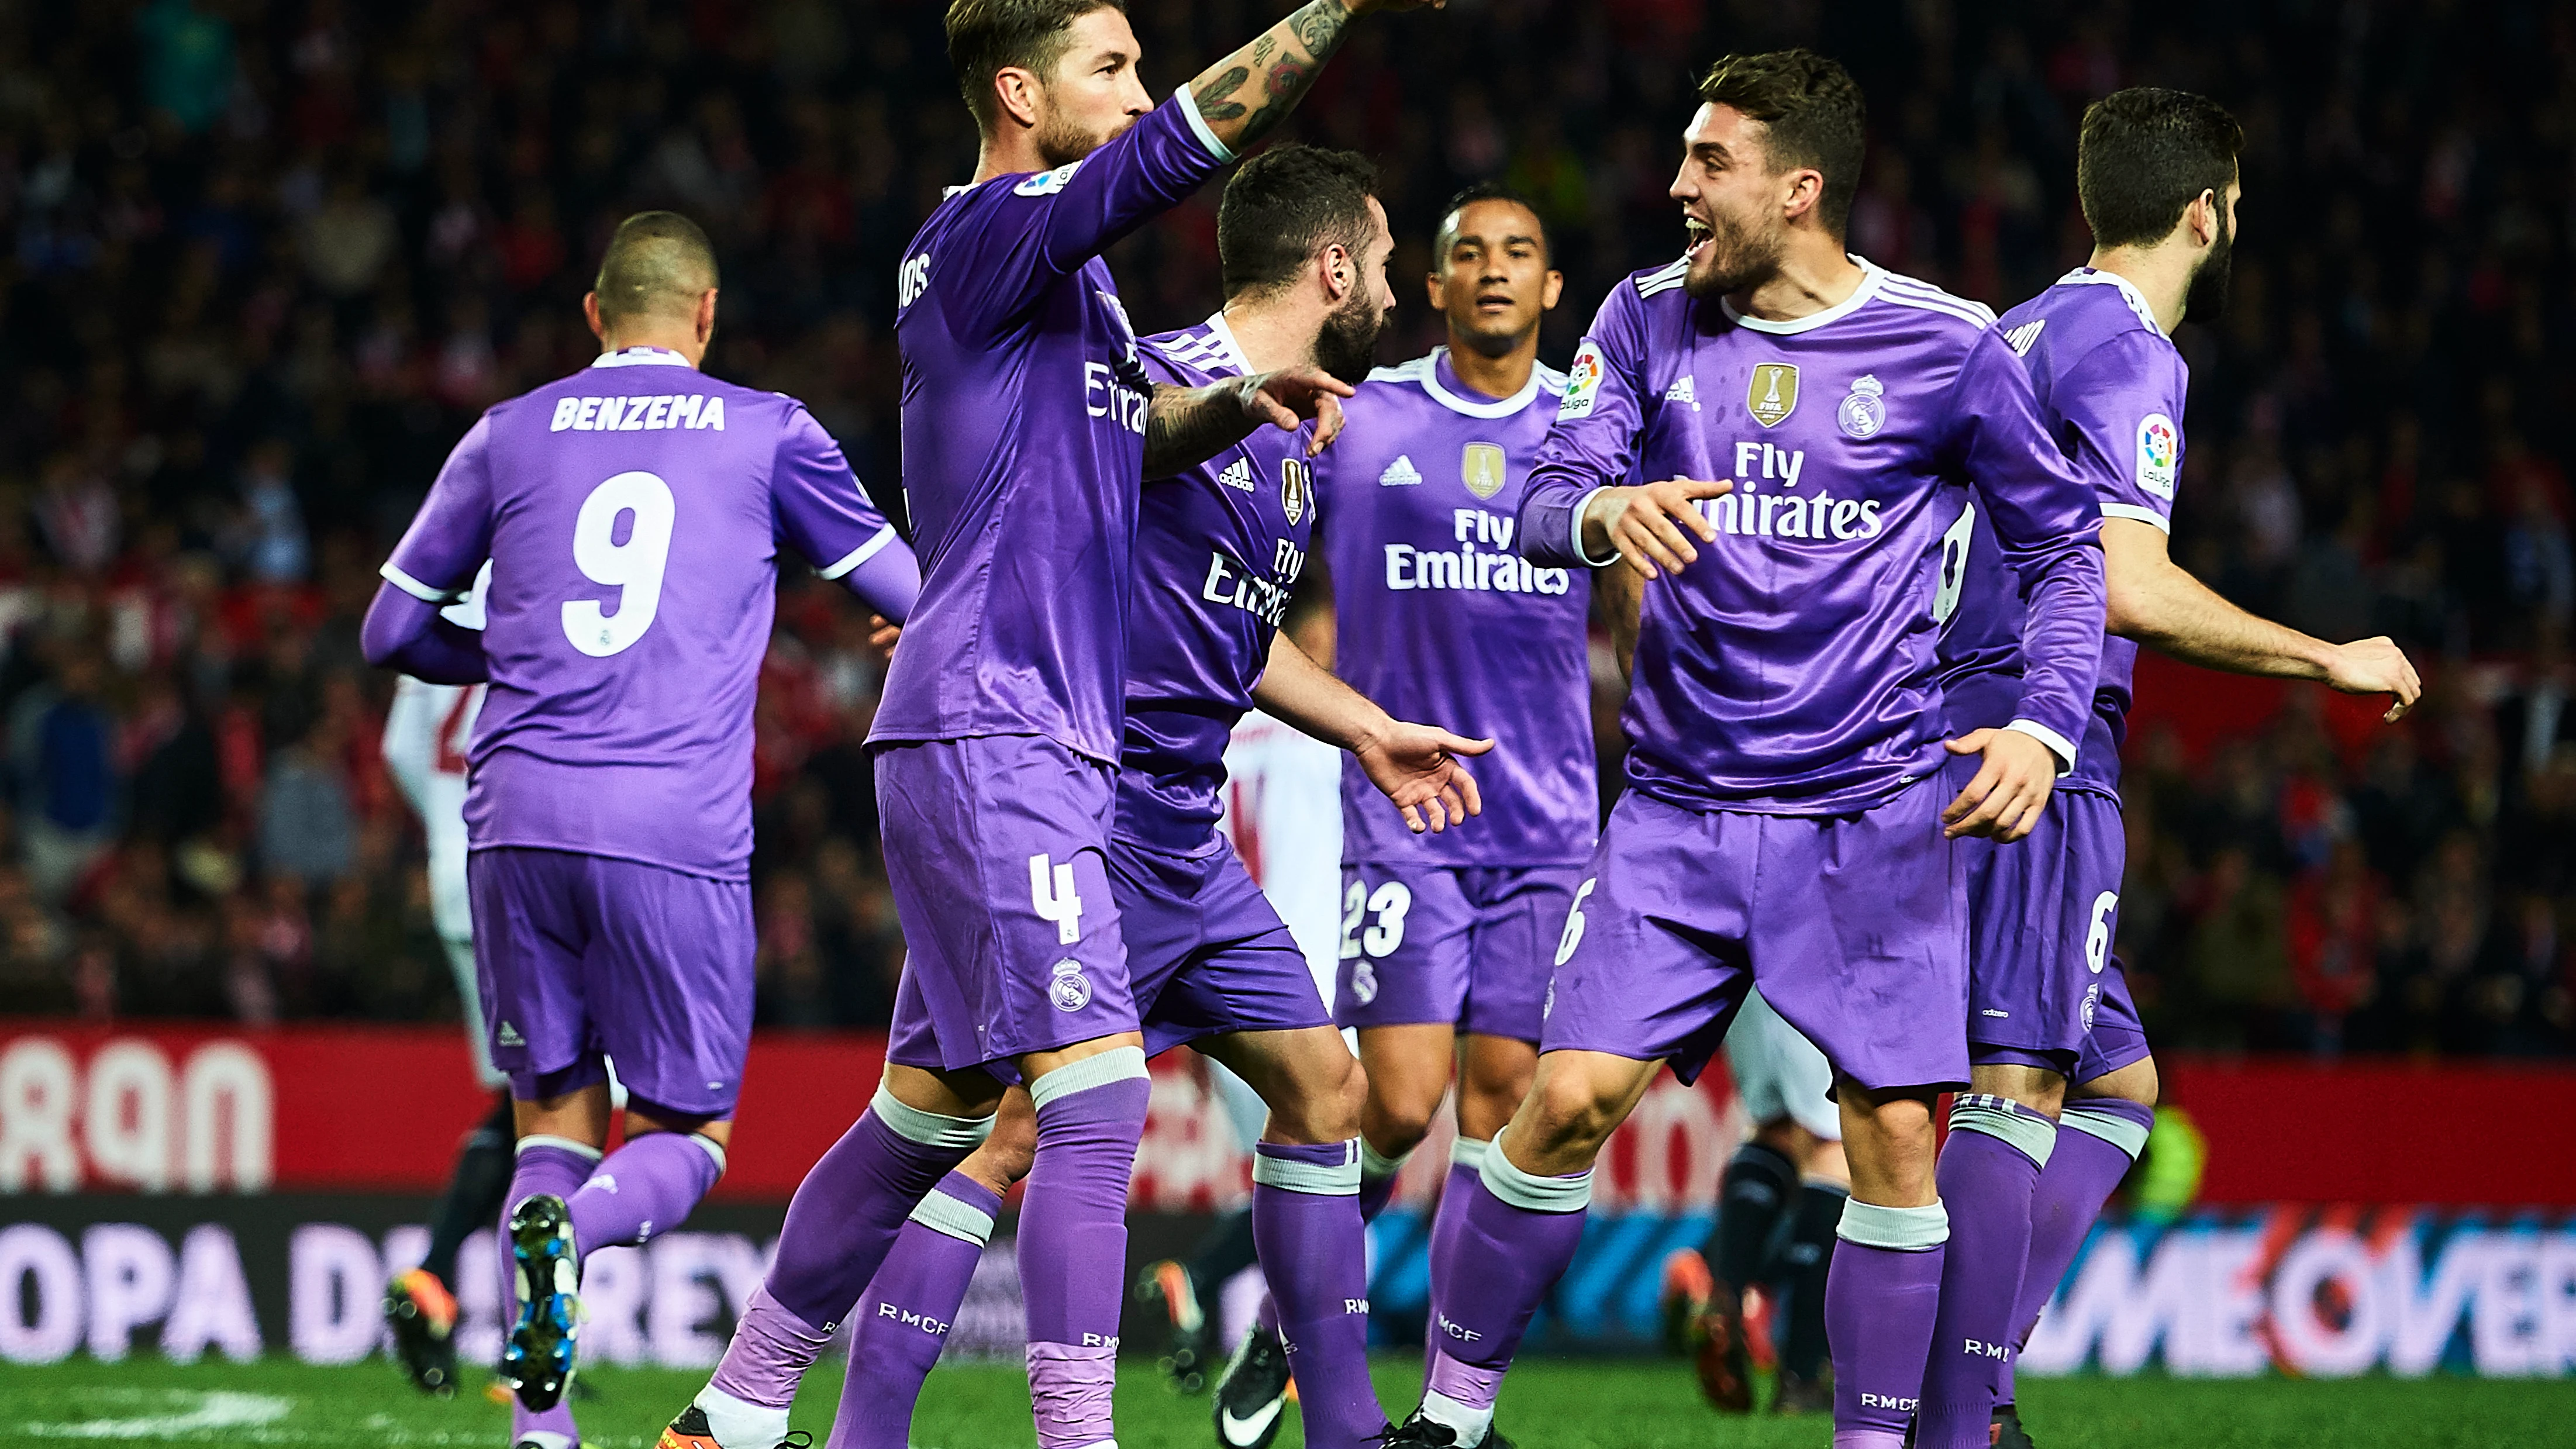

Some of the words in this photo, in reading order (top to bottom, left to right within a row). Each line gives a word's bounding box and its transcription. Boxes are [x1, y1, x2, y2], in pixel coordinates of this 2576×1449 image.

[550, 394, 725, 432] BENZEMA
[1560, 398, 1589, 410] aLiga
[1219, 472, 1255, 493] adidas
[1735, 441, 1805, 487] Fly
[2143, 467, 2171, 488] LaLiga
[1674, 474, 1882, 540] mirates
[1454, 508, 1515, 551] Fly
[561, 471, 675, 657] 9
[1274, 537, 1305, 584] Fly
[1029, 853, 1082, 945] 4
[1339, 880, 1412, 960] 23
[2085, 891, 2119, 974] 6
[878, 1302, 949, 1335] RMCF
[1861, 1393, 1919, 1411] RMCF
